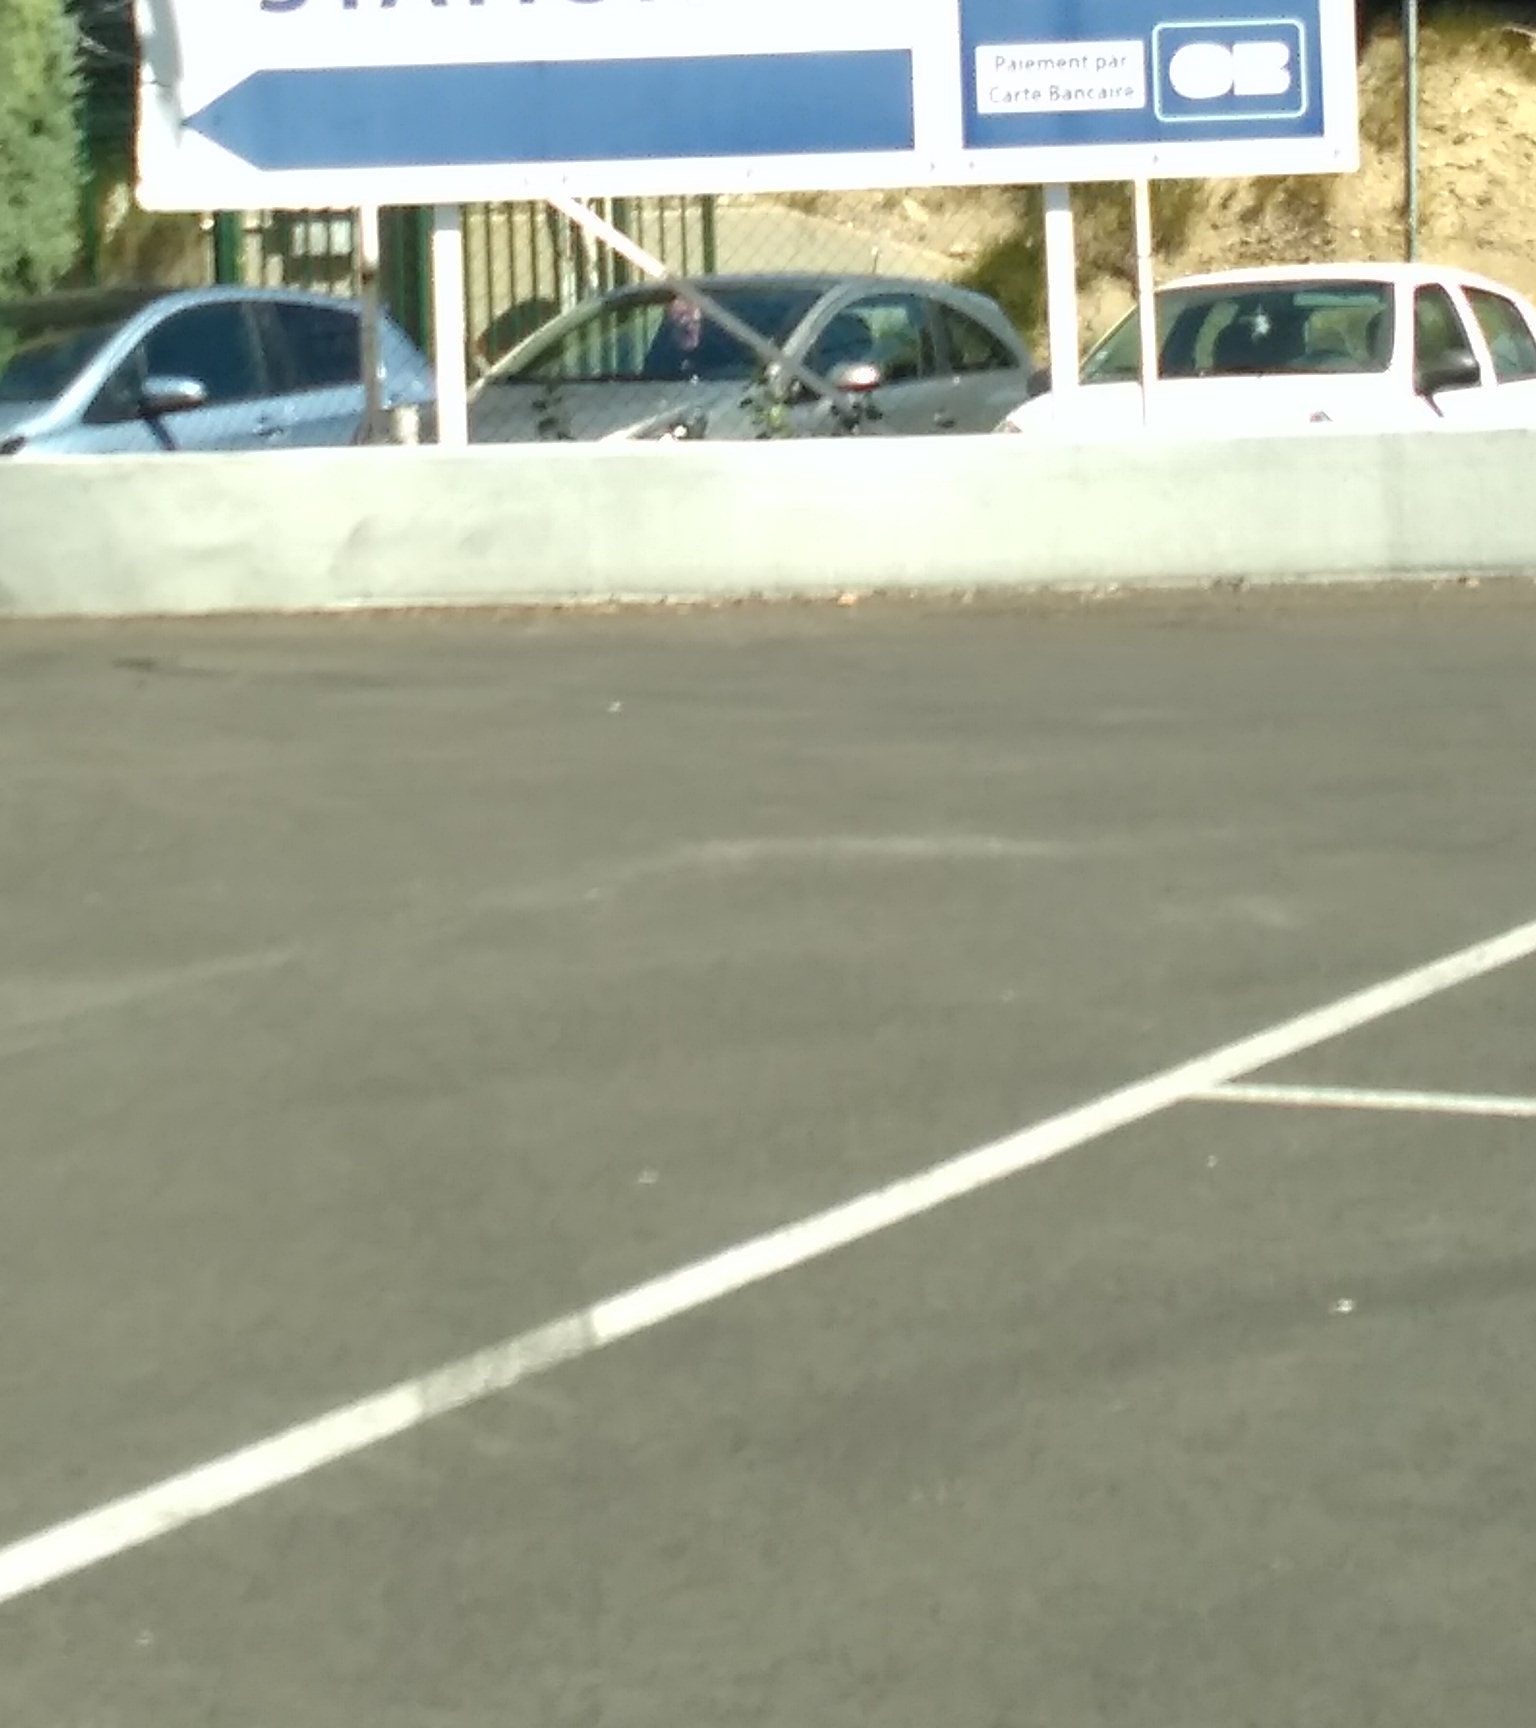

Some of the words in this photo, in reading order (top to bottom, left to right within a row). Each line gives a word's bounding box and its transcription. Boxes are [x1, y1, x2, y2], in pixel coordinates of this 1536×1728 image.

[994, 54, 1089, 73] Paiement
[1095, 54, 1128, 76] par
[989, 85, 1042, 104] Carte
[1048, 83, 1135, 102] Bancaire
